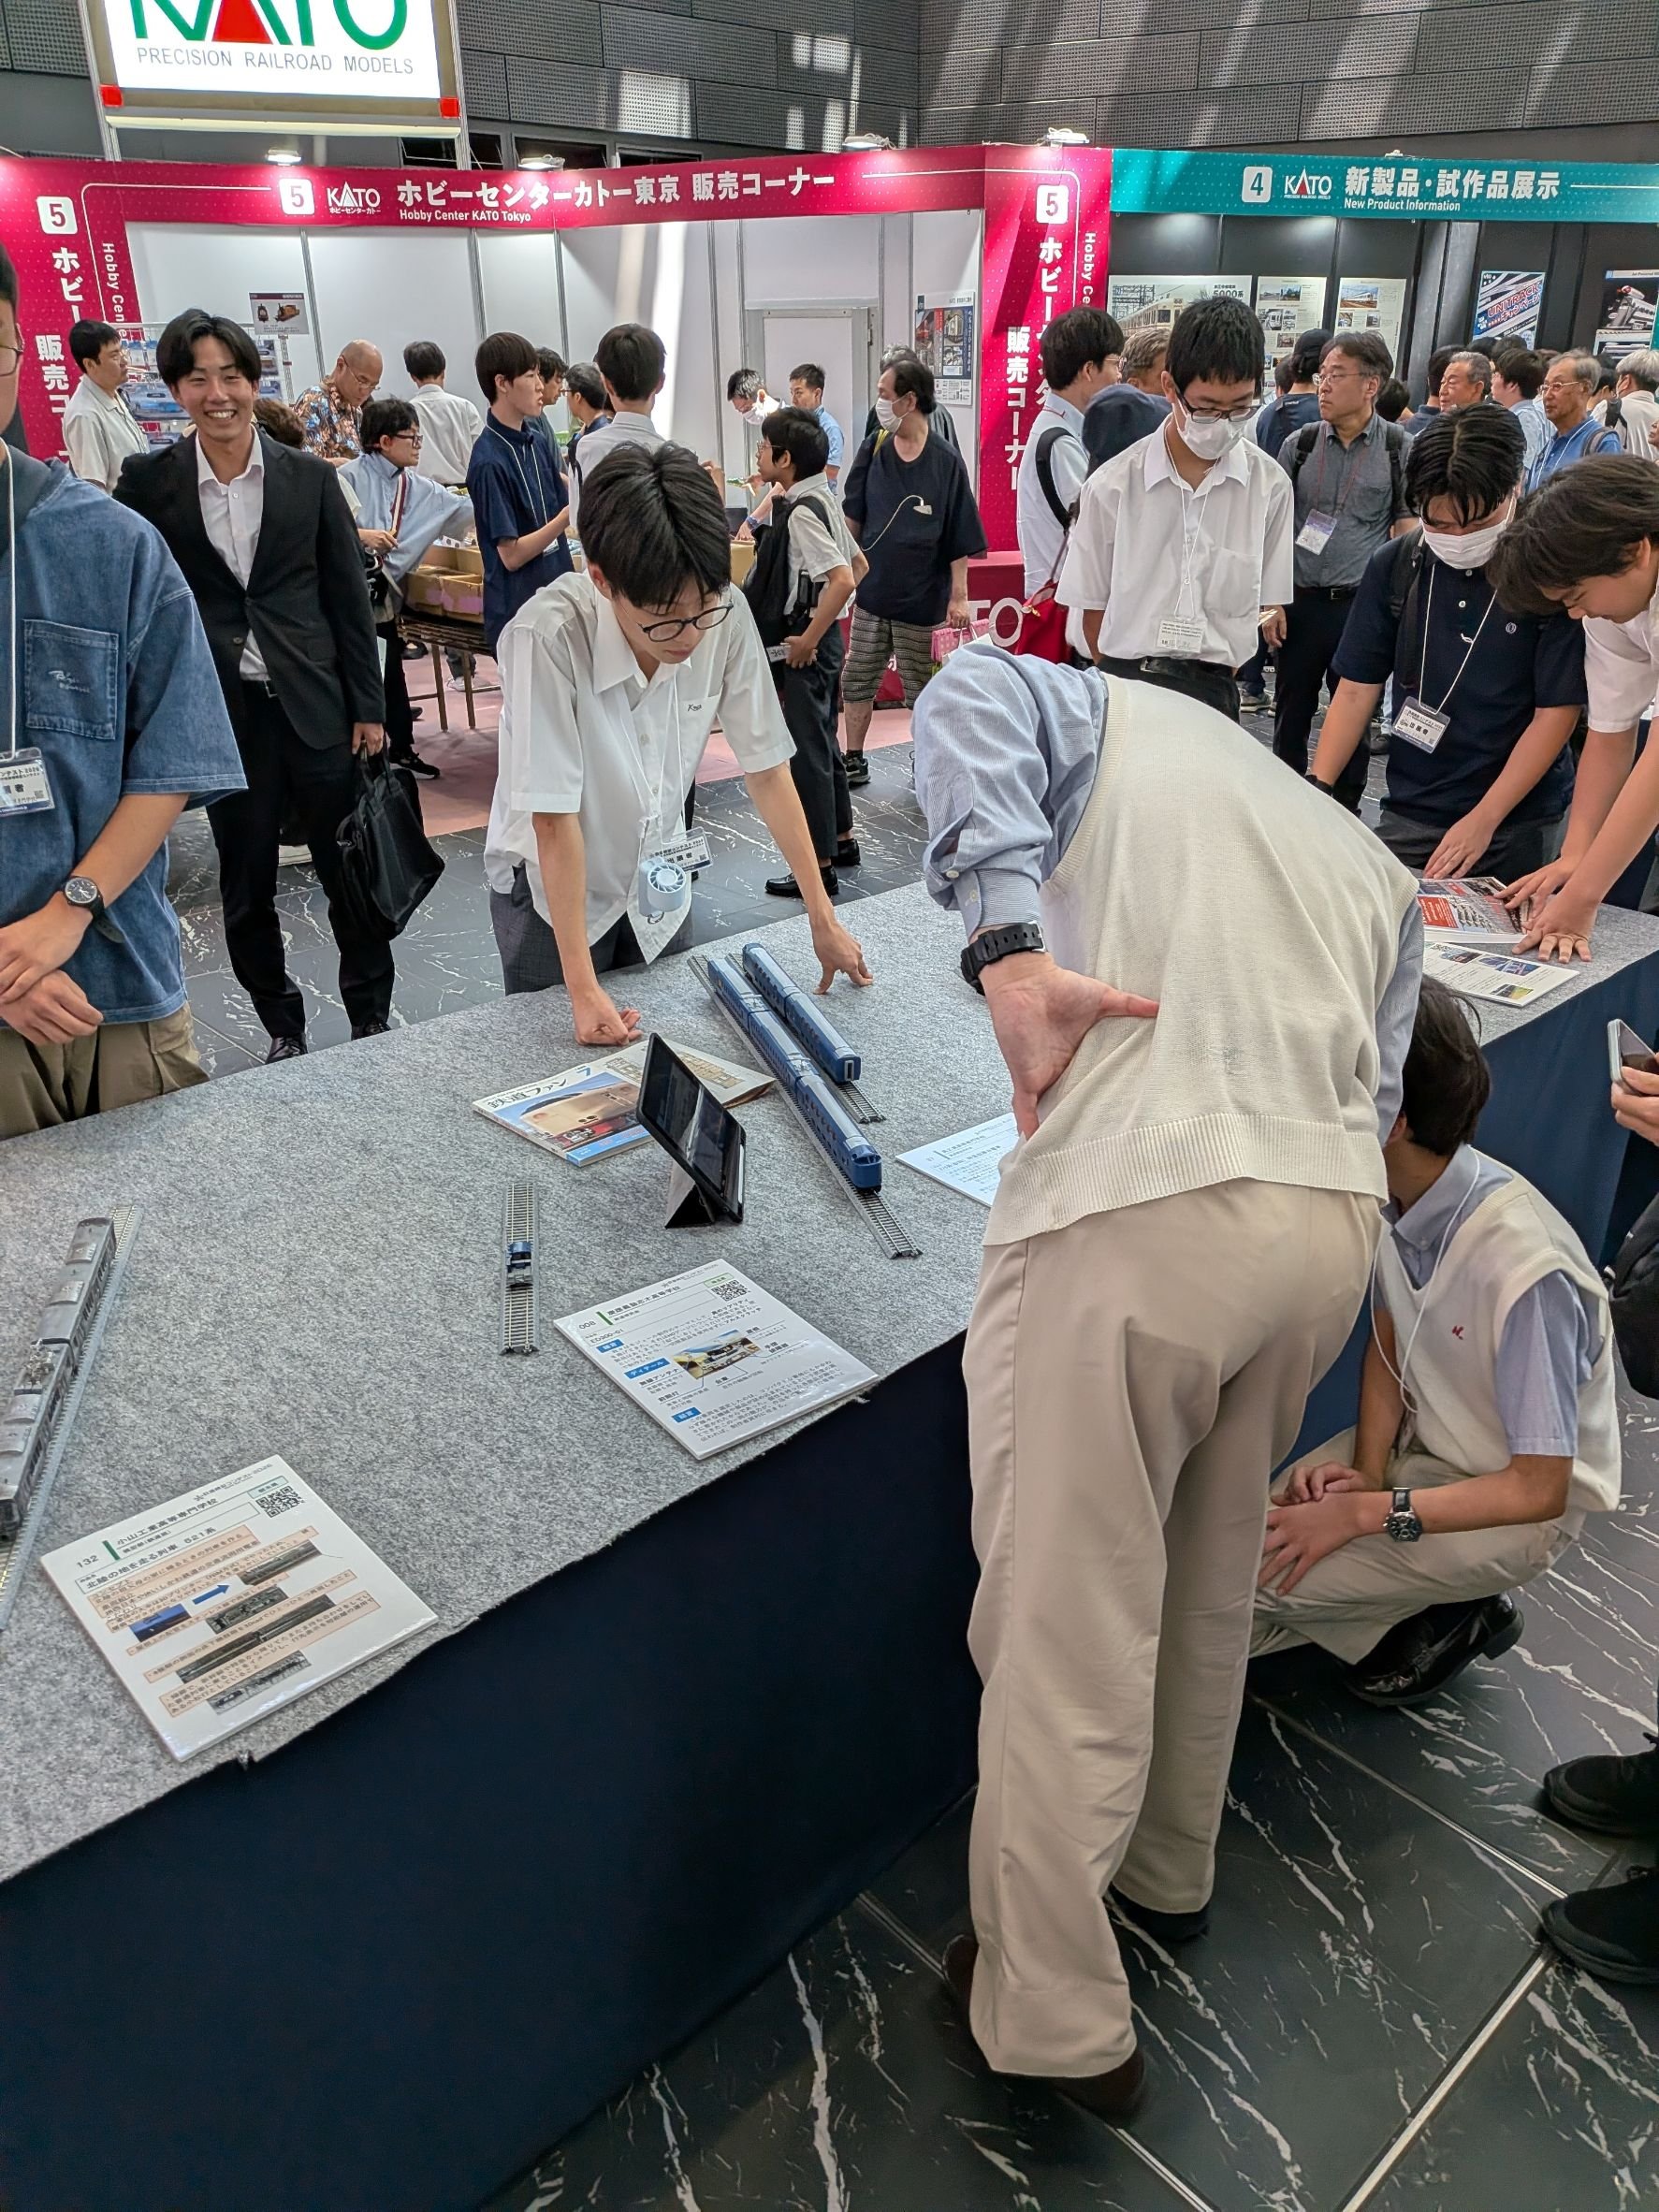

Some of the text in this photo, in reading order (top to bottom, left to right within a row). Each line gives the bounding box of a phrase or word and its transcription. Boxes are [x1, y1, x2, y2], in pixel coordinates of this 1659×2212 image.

[137, 46, 414, 75] PRECISION RAILROAD MODELS
[327, 181, 381, 208] KATO
[397, 167, 835, 211] ホビーセンターカトー東京 販売コーナー
[1249, 171, 1264, 196] 4
[1284, 167, 1332, 196] KATO
[1345, 166, 1560, 200] 新製品・試作品展示
[291, 185, 305, 208] 5
[1045, 192, 1058, 216] 5
[1344, 197, 1363, 210] New
[1366, 198, 1404, 211] Product
[1405, 198, 1461, 211] Information
[49, 203, 66, 227] 5
[400, 209, 531, 224] Hobby Center KATO Tokyo
[102, 241, 121, 291] Hobby
[1082, 231, 1097, 281] Hobby
[1488, 282, 1540, 317] UNITRACK
[488, 1078, 567, 1109] 鉄道ファン
[577, 1319, 597, 1330] 008
[628, 1359, 666, 1376] ディテール
[637, 1366, 680, 1387] 無線アンテナ
[713, 1375, 730, 1384] 台車
[115, 1496, 219, 1546] 小山工業高等専門学校
[75, 1553, 100, 1568] 132
[84, 1525, 217, 1589] 北陸の地を走る列車 521系
